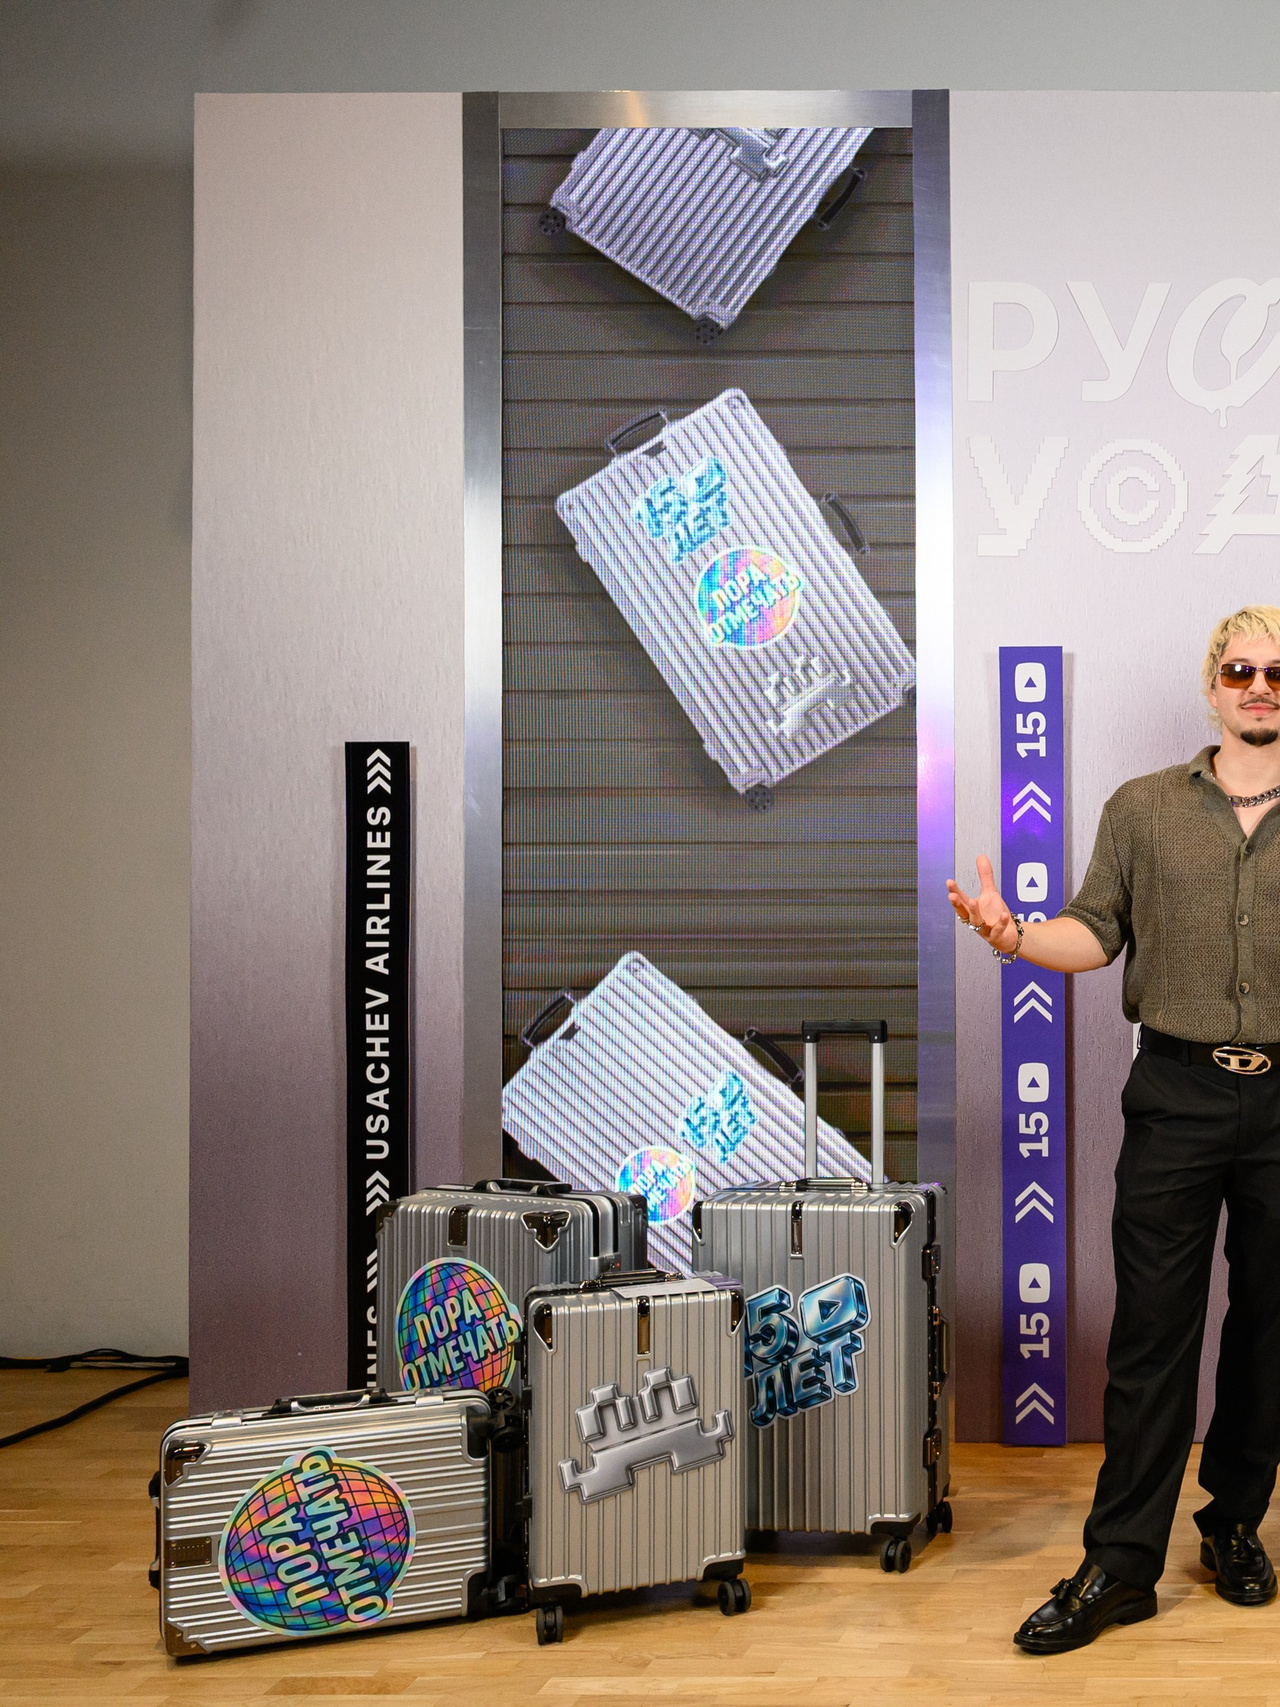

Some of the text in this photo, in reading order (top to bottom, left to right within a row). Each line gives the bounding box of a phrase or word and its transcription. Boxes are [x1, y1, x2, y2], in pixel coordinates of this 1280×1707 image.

[710, 563, 768, 611] ПОРА
[710, 571, 802, 644] ОТМЕЧАТЬ
[1016, 712, 1046, 758] 15
[366, 805, 392, 1160] USACHEV AIRLINES
[1018, 1110, 1049, 1159] 15
[402, 1312, 520, 1392] ОТМЕЧАТЬ
[413, 1288, 483, 1349] ПОРА
[744, 1287, 799, 1378] 5
[1018, 1312, 1050, 1360] 15
[750, 1331, 863, 1427] ЛЕТ
[258, 1506, 331, 1609] ПОРА
[293, 1453, 386, 1623] ОТМЕЧАТЬ
